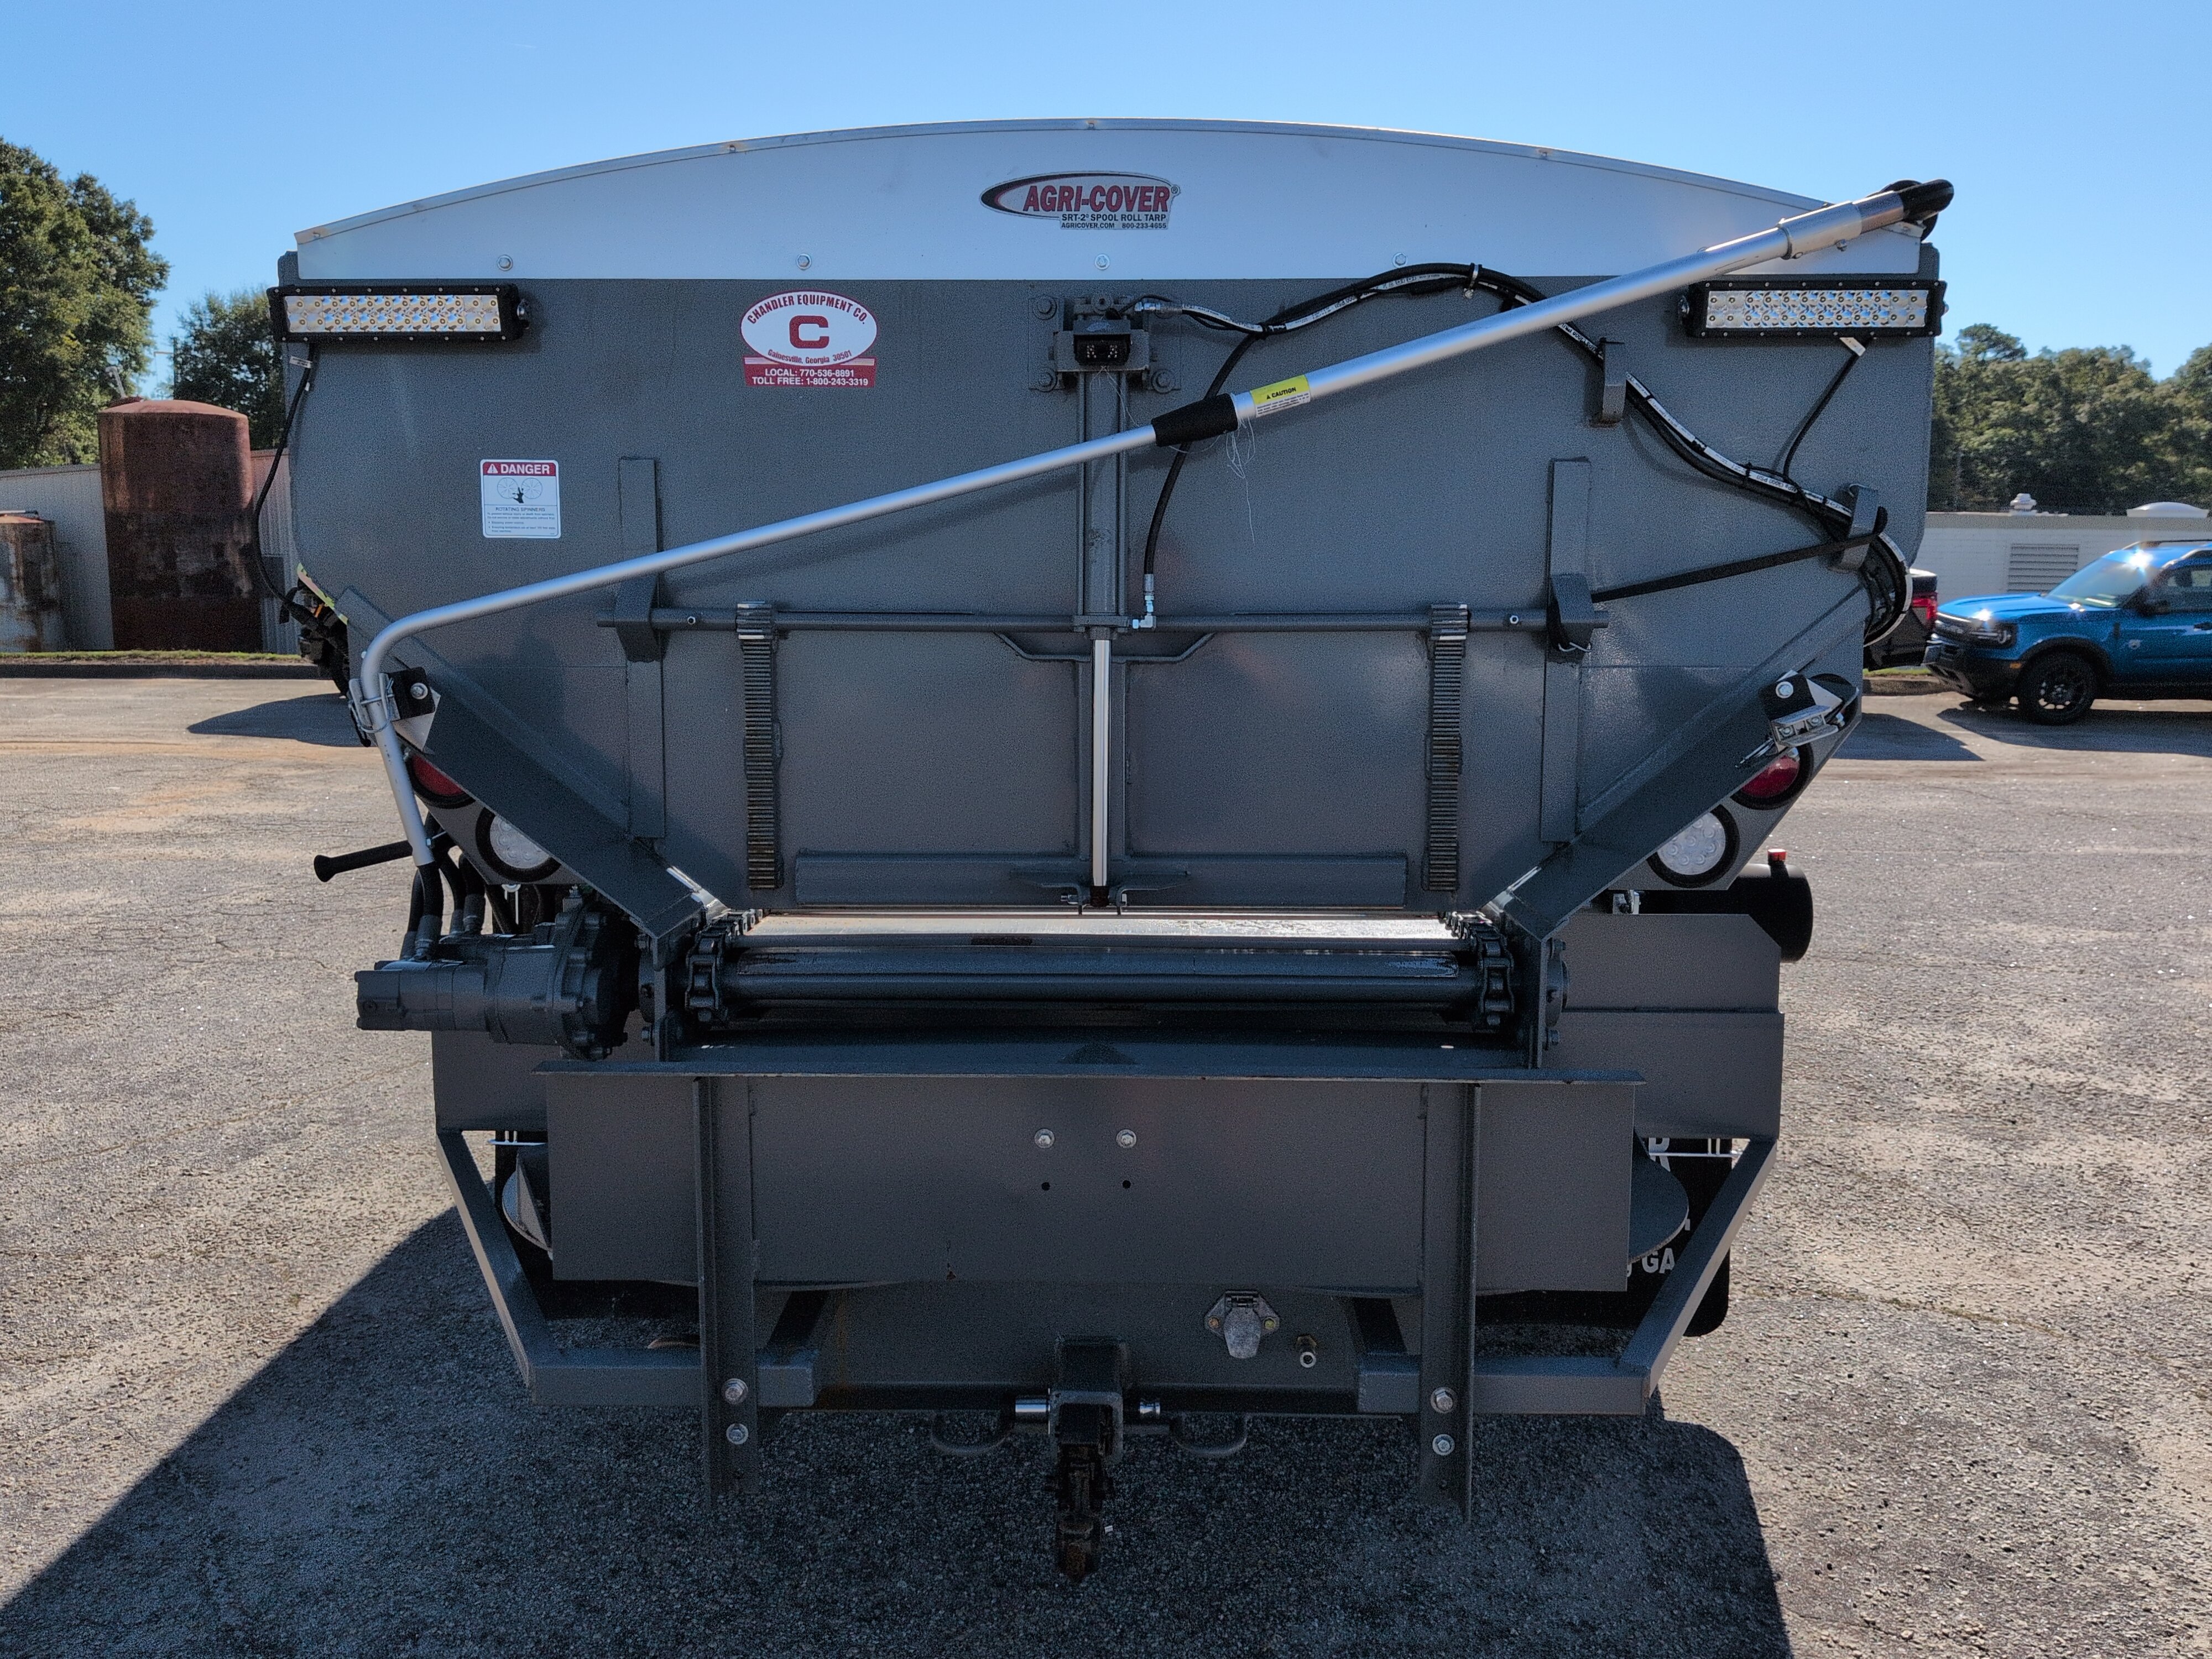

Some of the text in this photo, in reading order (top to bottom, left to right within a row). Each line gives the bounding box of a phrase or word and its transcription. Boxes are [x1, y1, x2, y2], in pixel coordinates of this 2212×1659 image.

[747, 294, 868, 325] CHANDLER EQUIPMENT CO.
[789, 315, 830, 349] C
[768, 349, 852, 364] Gainesville, Georgia 30501
[765, 368, 854, 377] LOCAL: 770-536-8891
[806, 377, 868, 386] 1-800-243-3319
[1271, 387, 1297, 398] CAUTION
[500, 464, 550, 474] DANGER
